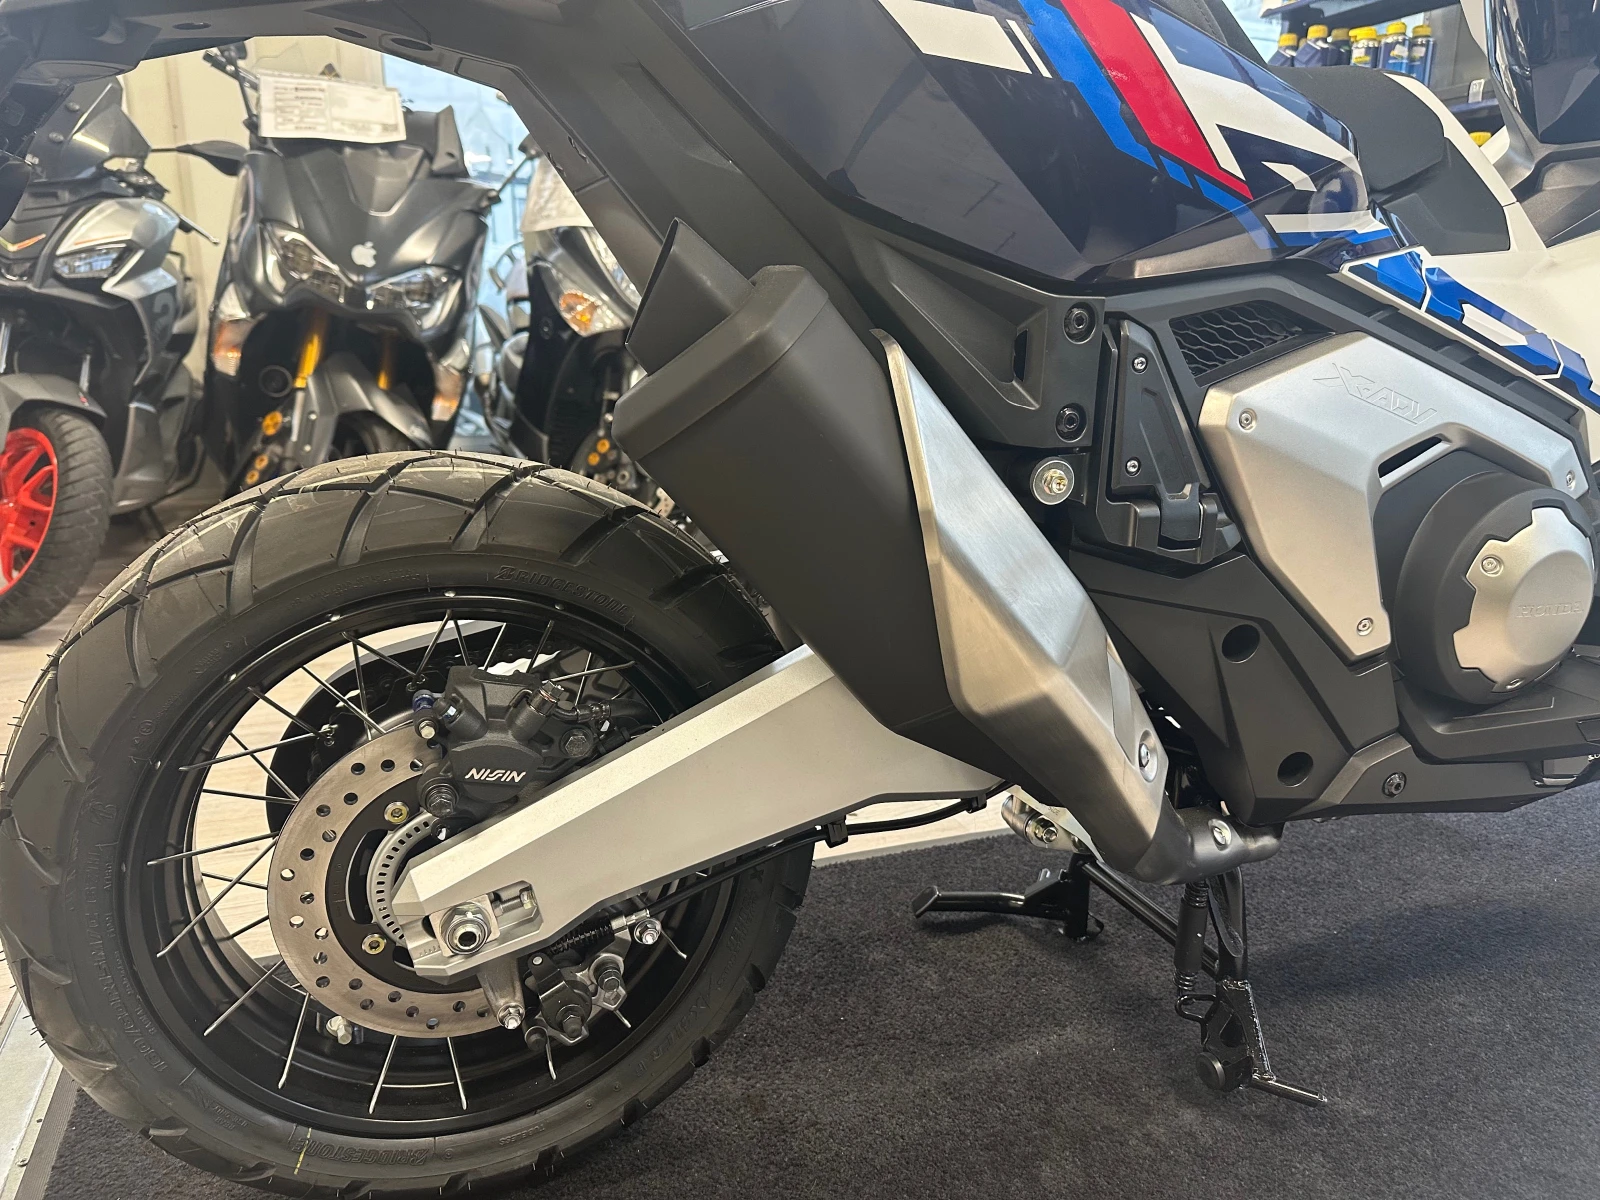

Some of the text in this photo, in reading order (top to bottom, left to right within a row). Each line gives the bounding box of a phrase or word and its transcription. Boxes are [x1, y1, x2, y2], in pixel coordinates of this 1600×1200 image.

[1313, 363, 1438, 427] X-ADV
[494, 565, 629, 617] BRIDGESTONE
[1516, 601, 1584, 618] HONDA
[292, 1138, 429, 1166] BRIDGESTONE
